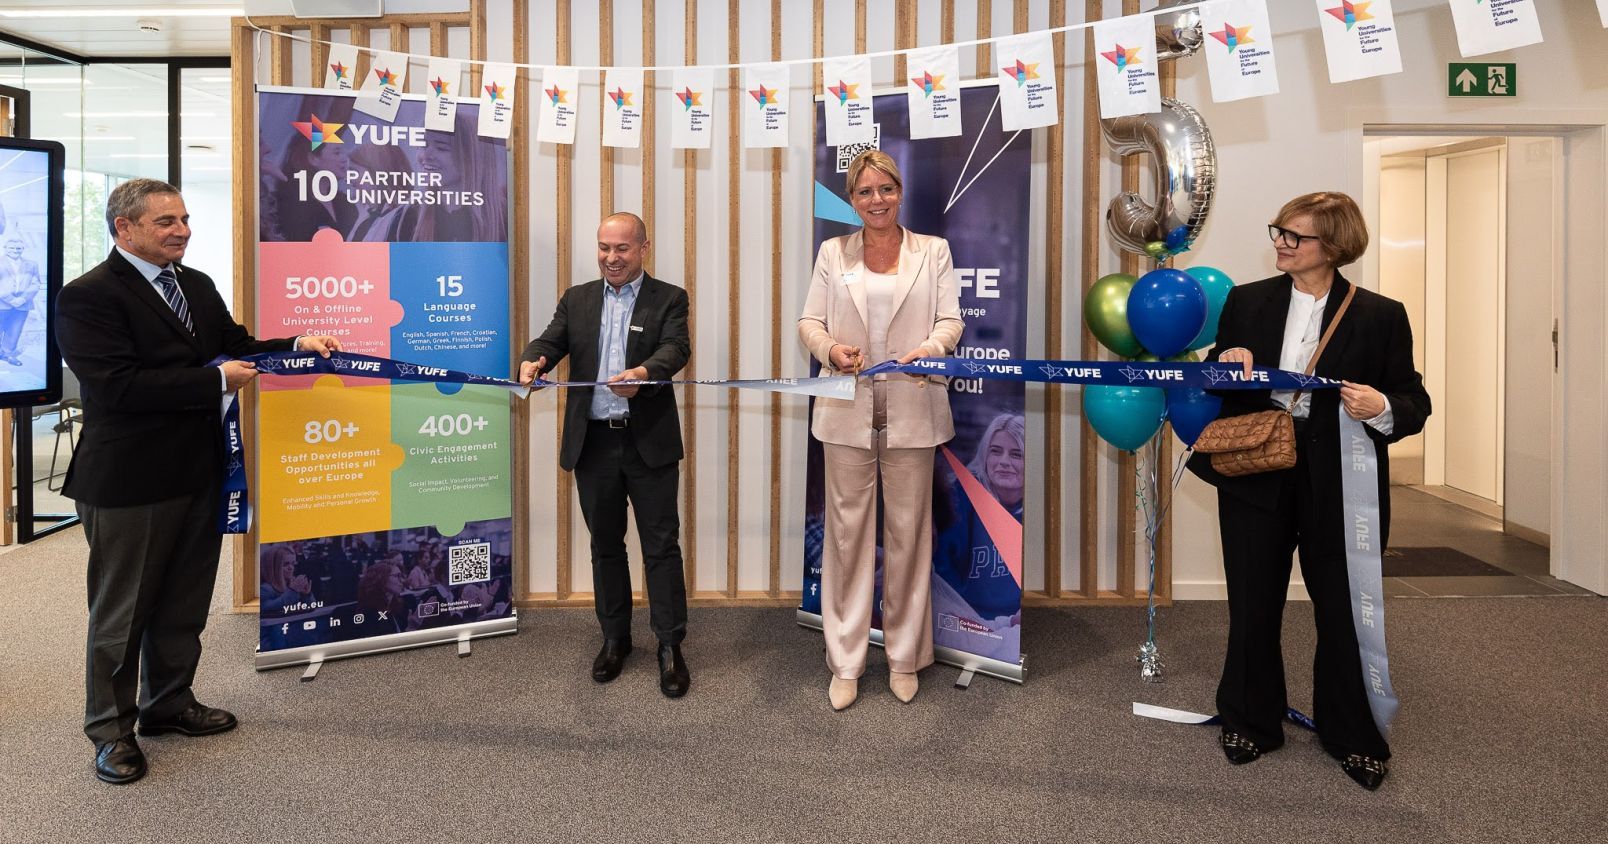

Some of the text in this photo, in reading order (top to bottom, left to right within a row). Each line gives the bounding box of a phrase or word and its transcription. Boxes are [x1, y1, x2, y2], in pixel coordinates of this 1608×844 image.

[1495, 18, 1518, 26] Europe
[348, 124, 426, 147] YUFE
[346, 171, 442, 188] PARTNER
[294, 170, 338, 202] 10
[346, 188, 484, 206] UNIVERSITIES
[286, 276, 375, 299] 5000+
[436, 275, 464, 298] 15
[953, 268, 1000, 298] FE
[294, 304, 362, 314] On & Offline
[424, 303, 476, 312] Language
[282, 315, 373, 326] University Level
[428, 314, 472, 322] Courses
[306, 328, 351, 336] Courses
[948, 346, 1010, 360] urope
[282, 358, 316, 369] YUFE
[351, 360, 381, 372] YUFE
[912, 360, 946, 369] YUFE
[417, 366, 448, 377] YUFE
[987, 365, 1022, 375] YUFE
[1064, 368, 1102, 378] YUFE
[1145, 370, 1183, 380] YUFE
[418, 414, 488, 437] 400+
[230, 421, 240, 454] YUFE
[304, 420, 360, 444] 80+
[410, 442, 498, 455] Civic Engagement
[280, 448, 380, 463] Staff Development
[431, 455, 478, 464] Activities
[286, 460, 376, 474] Opportunities all
[299, 472, 364, 484] over Europe
[283, 496, 314, 504] Enhanced
[227, 491, 241, 525] YUFE
[283, 601, 324, 614] yufe.eu
